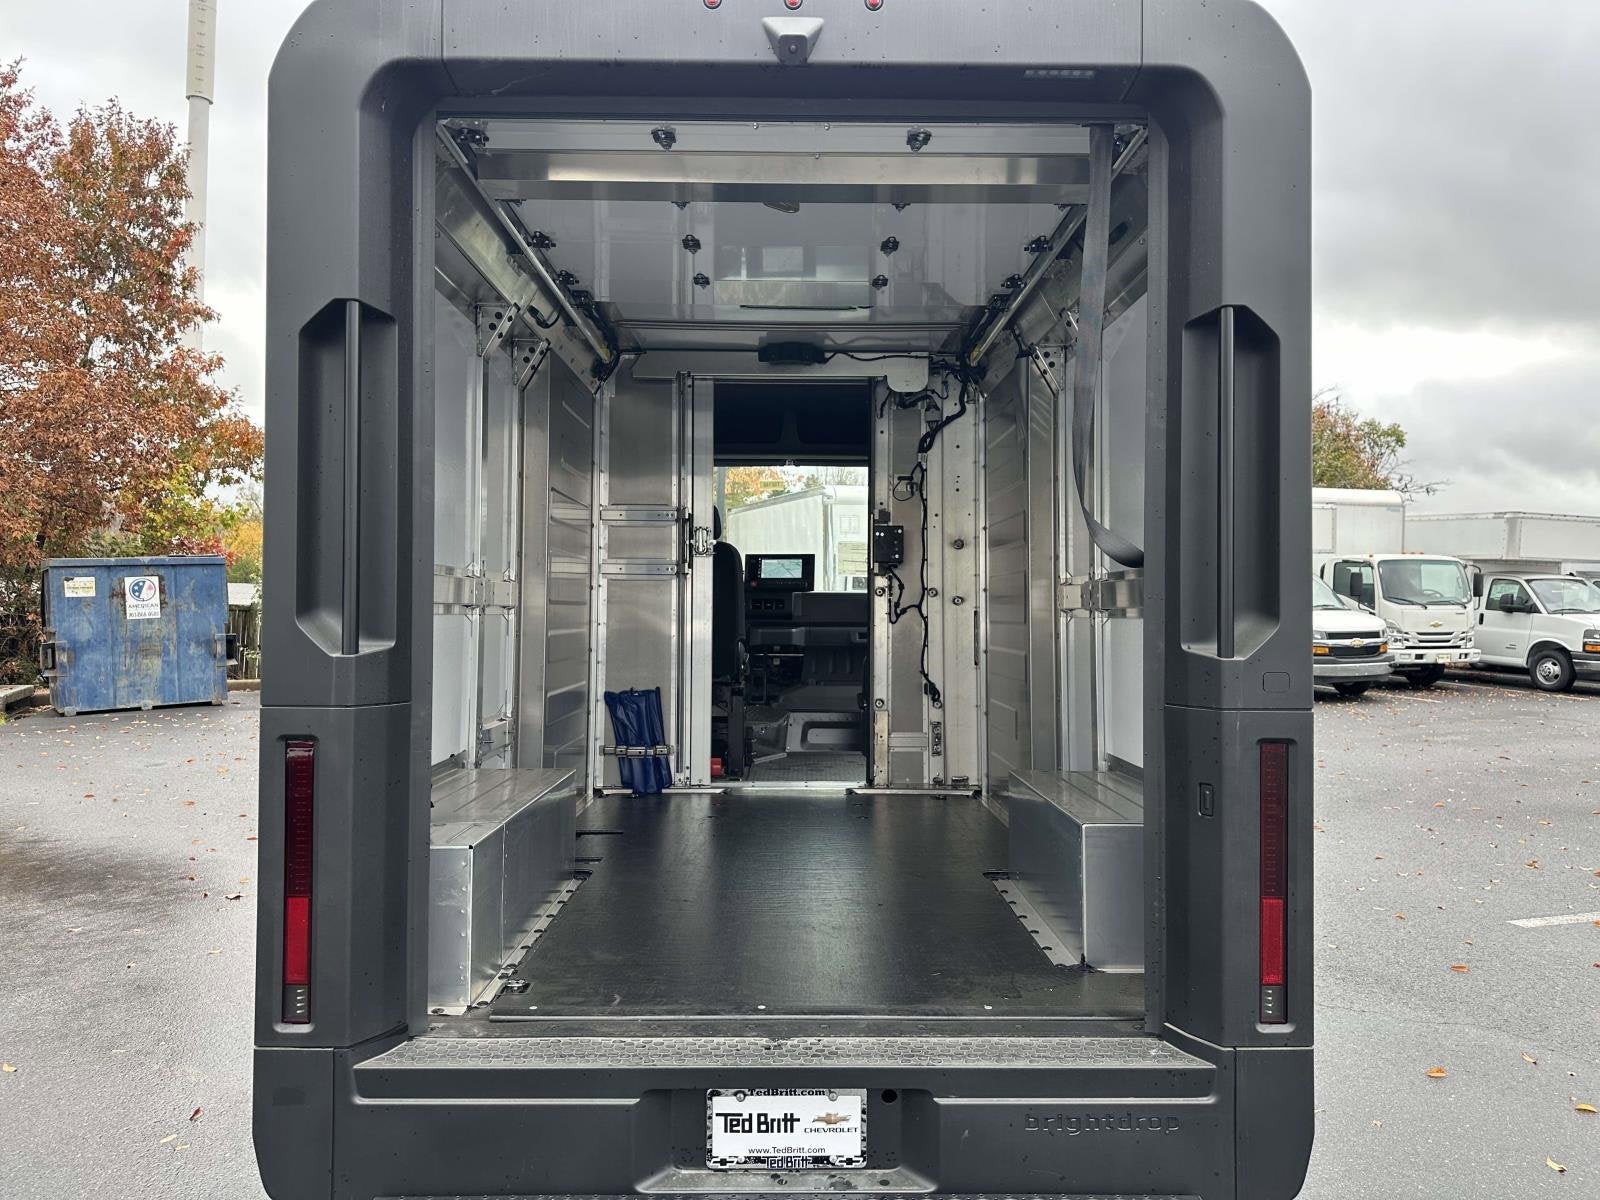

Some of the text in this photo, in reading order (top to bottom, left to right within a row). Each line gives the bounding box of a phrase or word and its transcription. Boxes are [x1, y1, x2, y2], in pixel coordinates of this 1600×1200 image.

[748, 1088, 826, 1097] TedBritt.com
[715, 1113, 800, 1134] Ted Britt
[1025, 1113, 1180, 1136] brightdrop
[764, 1157, 809, 1168] Ted Britt
